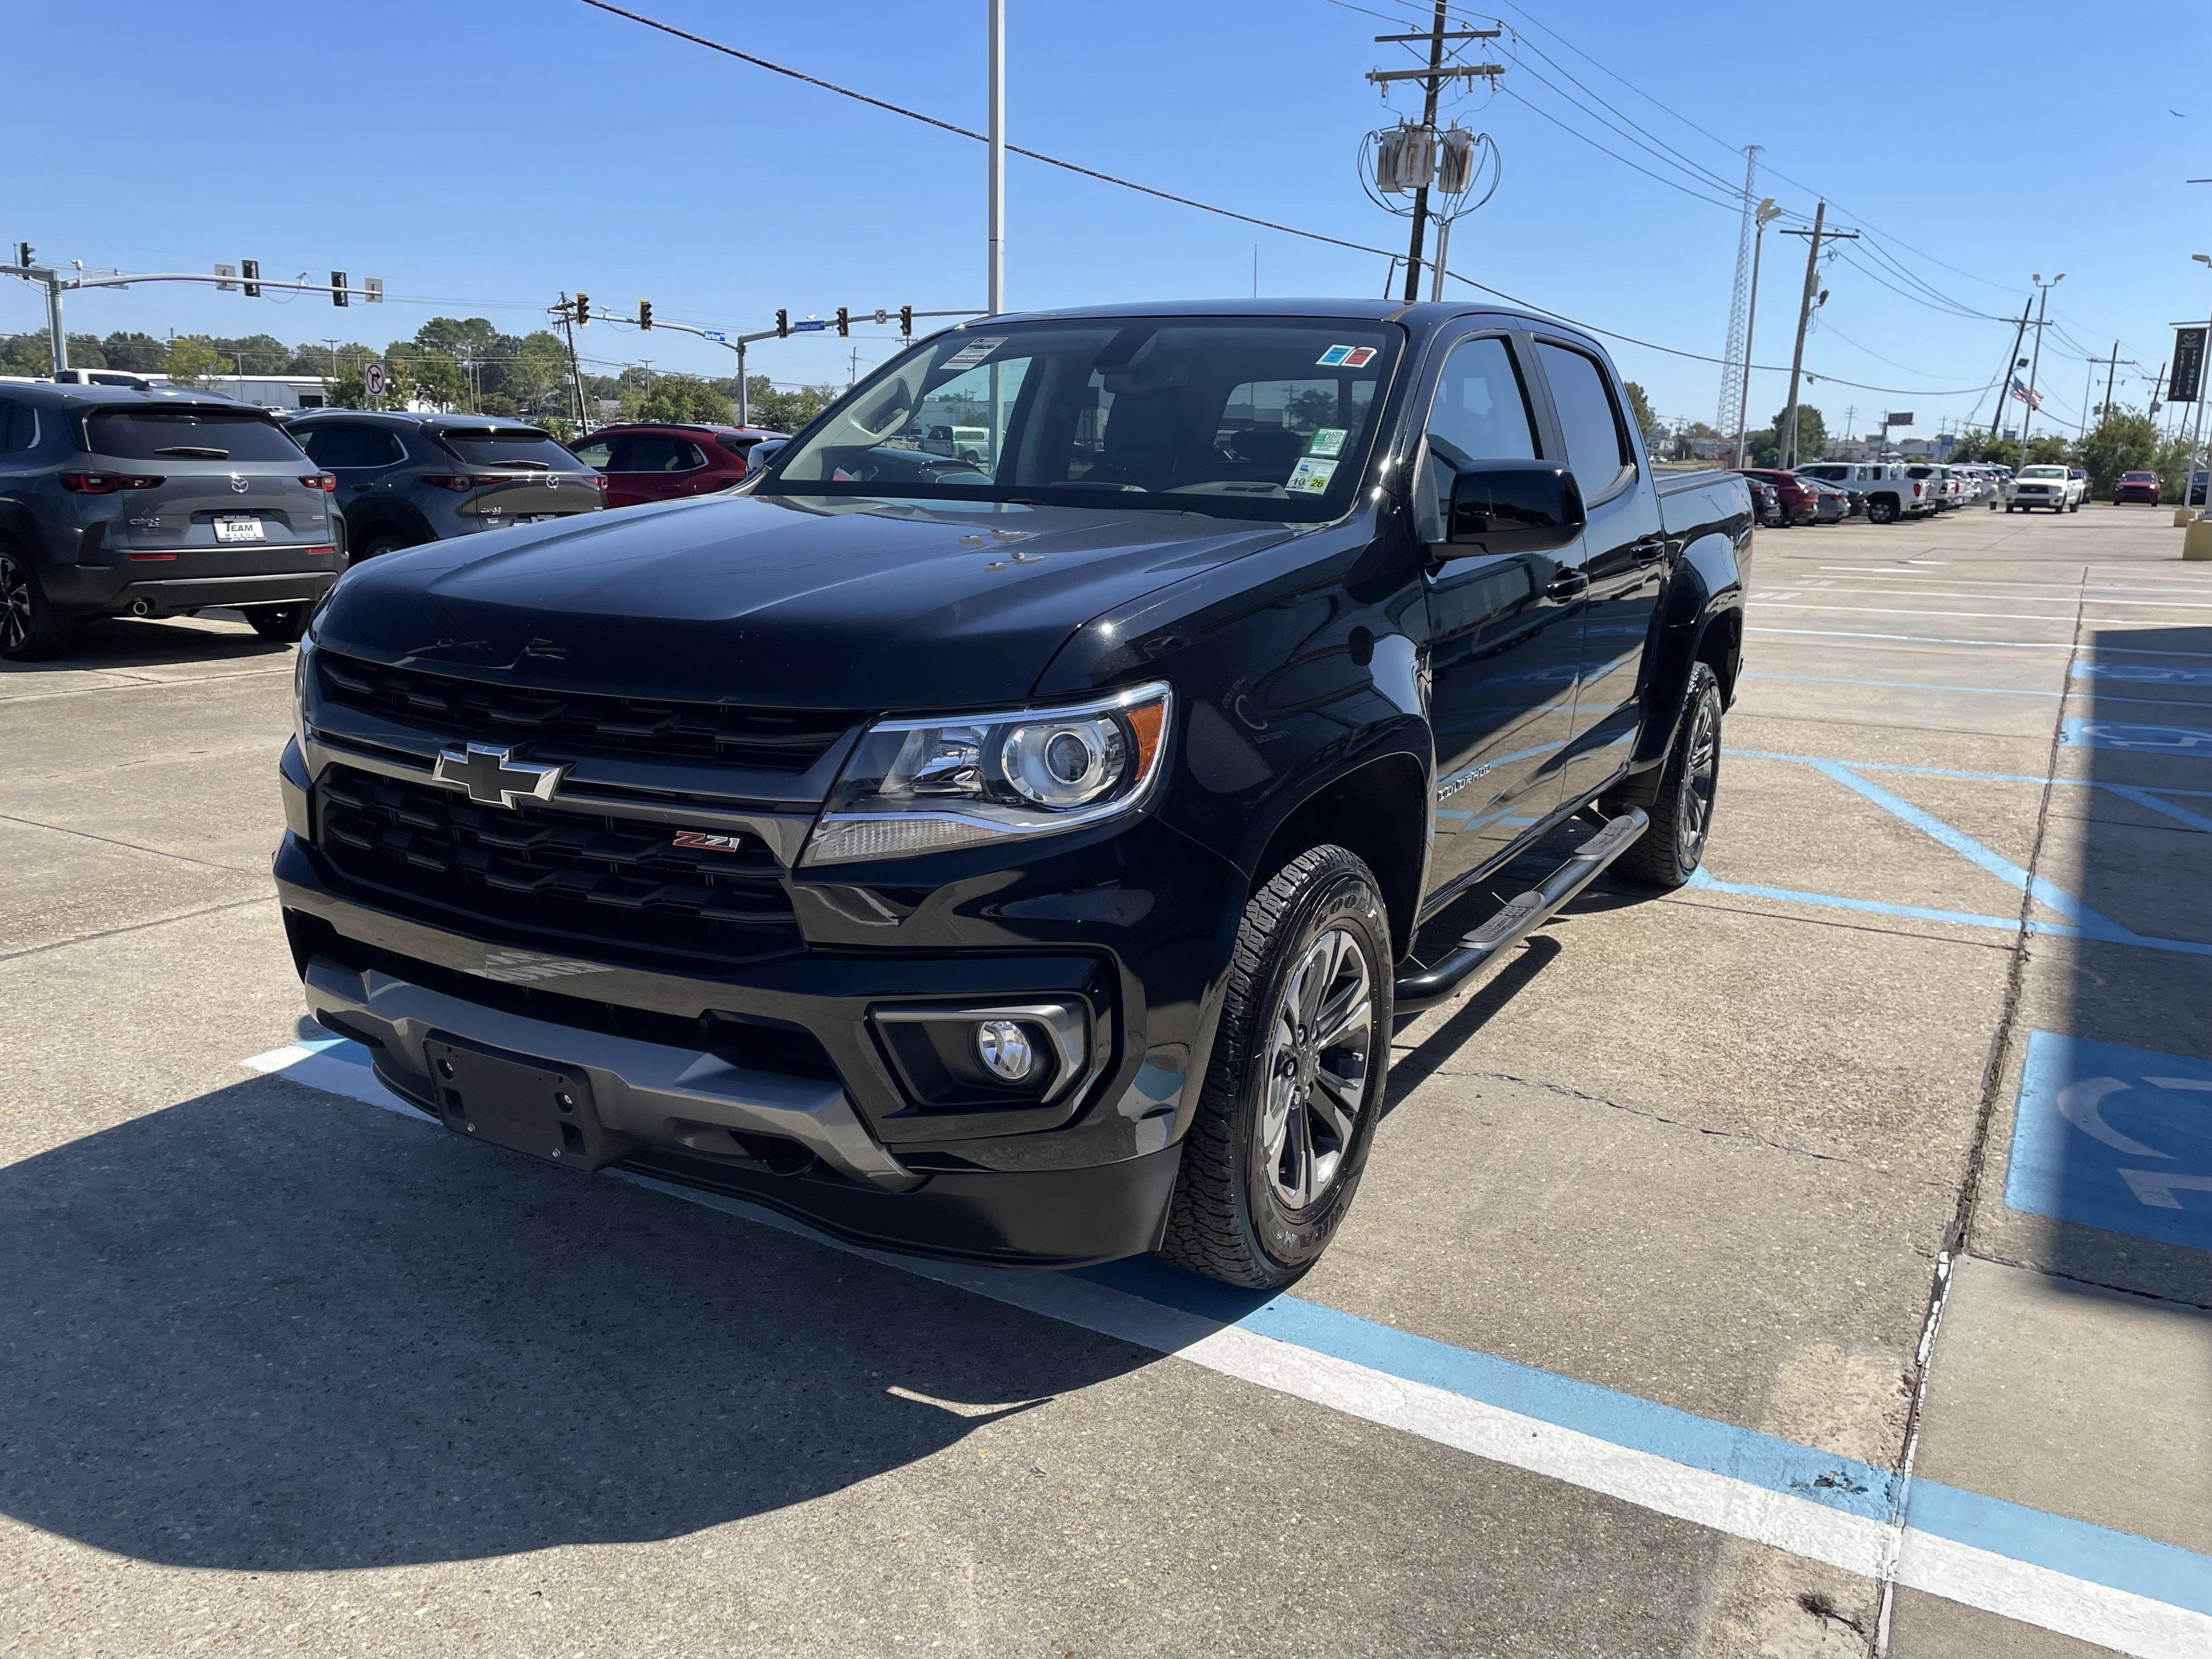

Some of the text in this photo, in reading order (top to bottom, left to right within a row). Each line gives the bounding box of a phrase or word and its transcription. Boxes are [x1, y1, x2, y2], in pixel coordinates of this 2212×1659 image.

[1310, 479, 1325, 488] 26
[223, 521, 253, 532] TEAM
[1437, 763, 1492, 802] COLORADO
[673, 831, 740, 852] Z71
